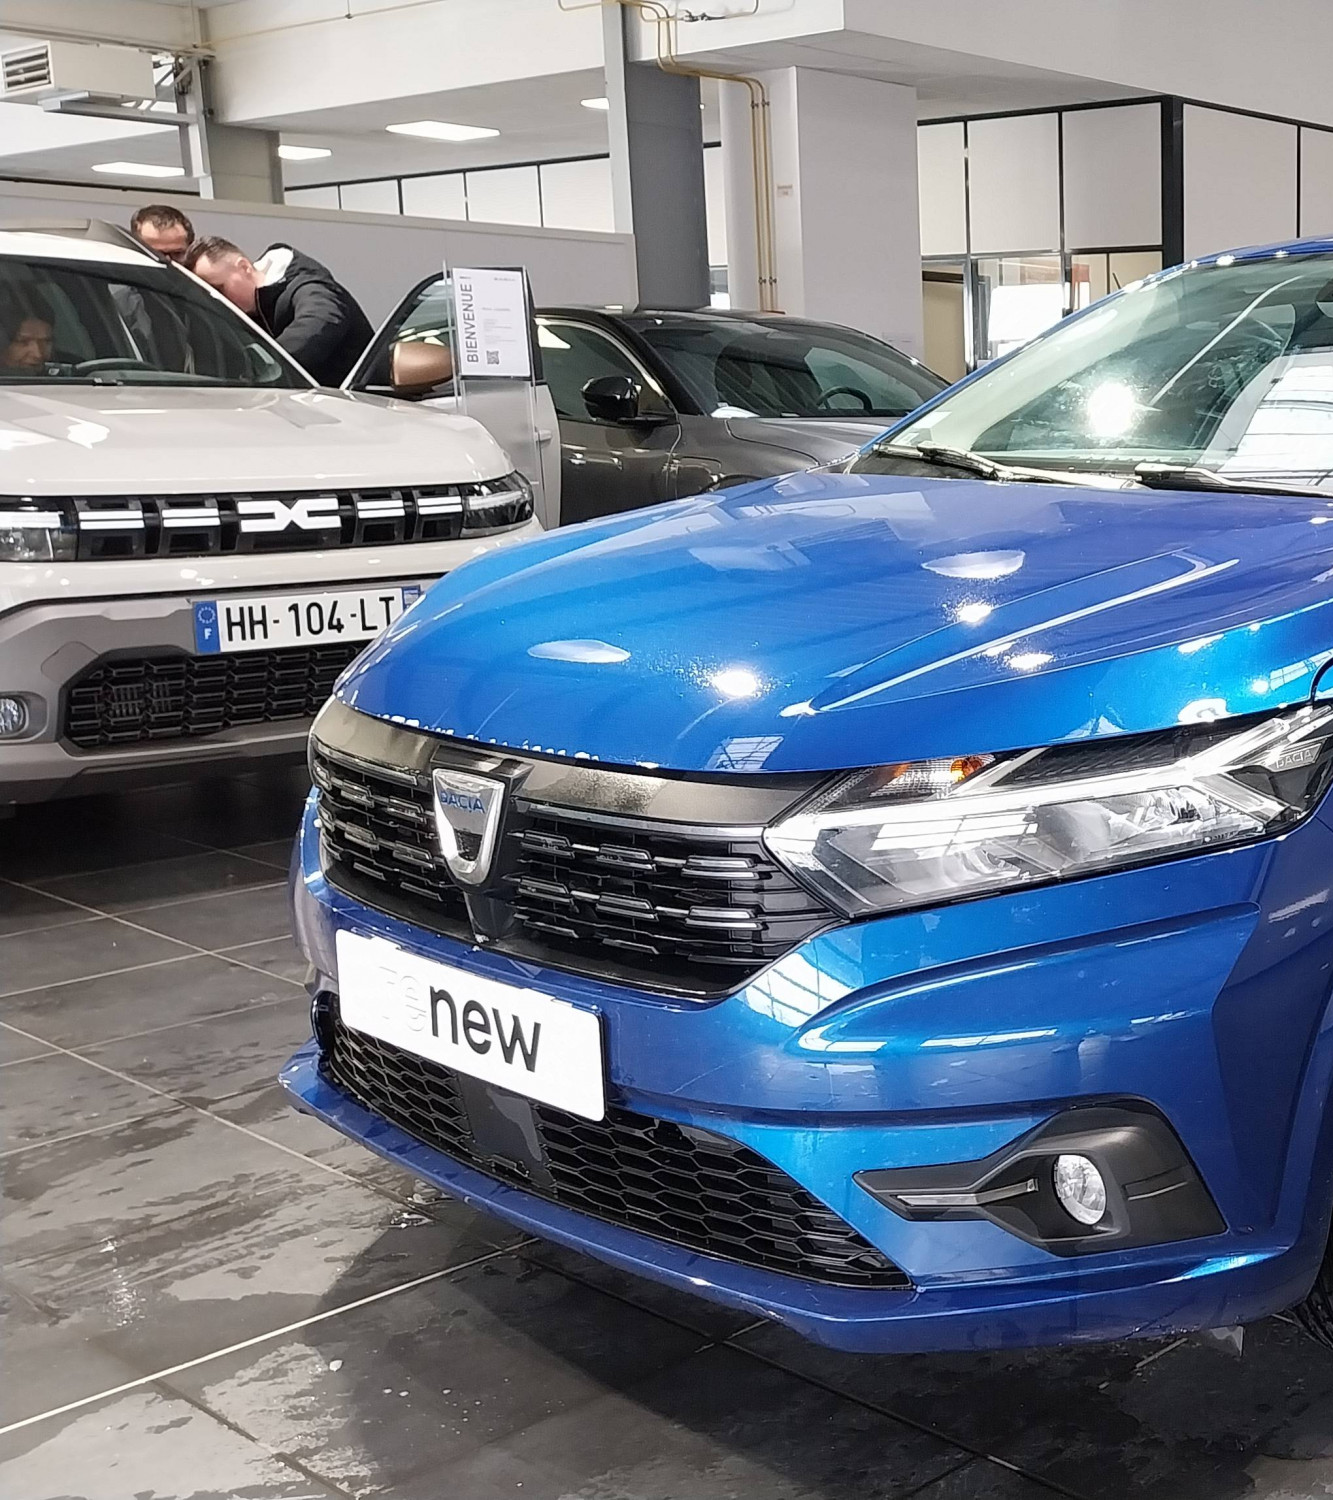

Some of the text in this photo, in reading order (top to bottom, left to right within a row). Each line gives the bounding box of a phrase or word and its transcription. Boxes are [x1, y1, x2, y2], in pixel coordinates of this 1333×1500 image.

[460, 283, 479, 363] BIENVENUE
[204, 628, 212, 640] F
[1275, 749, 1314, 769] DACIA
[440, 791, 486, 814] DACIA
